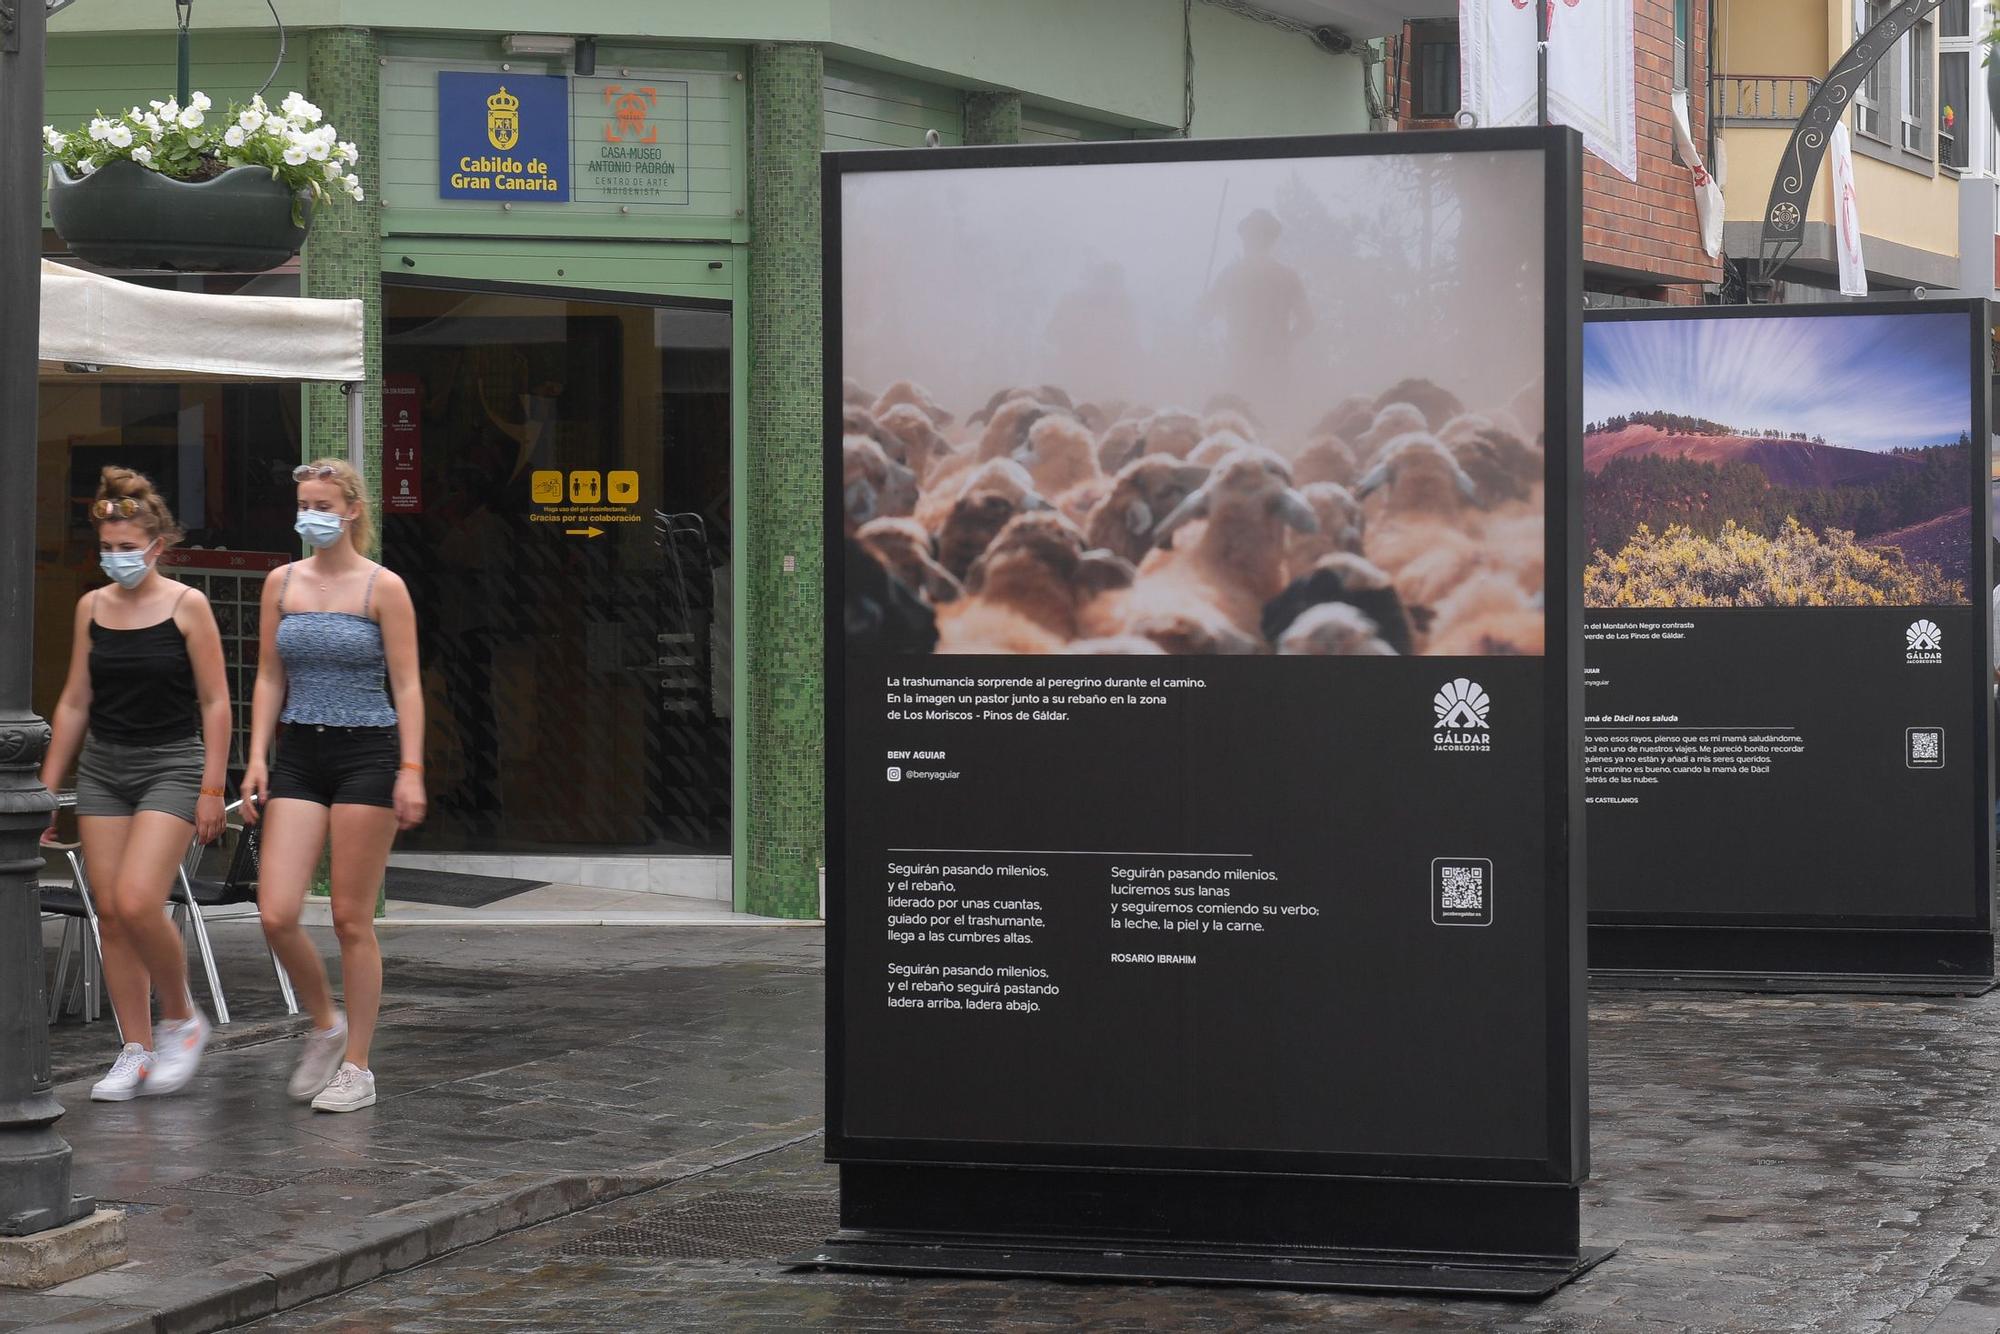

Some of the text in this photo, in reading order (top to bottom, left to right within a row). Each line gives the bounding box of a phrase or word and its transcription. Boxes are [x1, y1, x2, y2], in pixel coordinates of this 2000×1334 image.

[601, 146, 661, 161] CASA-MUSEO
[460, 156, 547, 174] Cabildo de
[588, 159, 675, 175] ANTONIO PADRÓN
[451, 173, 558, 191] Gran Canaria
[595, 176, 668, 187] CENTRO DE ARTE
[530, 513, 561, 522] Gracias
[562, 515, 576, 524] por
[589, 514, 641, 522] colaboración
[1639, 622, 1661, 630] Negro
[1906, 651, 1942, 660] GÁLDAR
[887, 676, 1207, 689] La trashumancia sorprende al peregrino durante el camino.
[887, 693, 901, 702] En
[904, 693, 913, 703] la
[915, 693, 955, 705] imagen
[958, 695, 972, 703] un
[975, 693, 1009, 705] pastor
[1011, 693, 1040, 705] junto
[1052, 695, 1065, 703] su
[1068, 694, 1107, 703] rebaño
[1110, 696, 1124, 704] en
[1127, 694, 1137, 704] la
[1140, 696, 1167, 704] zona
[887, 710, 1069, 720] de Los Moriscos Pinos de Gáldar.
[1433, 730, 1490, 743] GÁLDAR
[1654, 735, 1681, 743] pienso
[887, 750, 946, 759] BENY AGUIAR
[1674, 745, 1698, 753] viajes.
[1614, 756, 1624, 764] ya
[1736, 755, 1772, 763] queridos.
[906, 770, 960, 780] @benyaguiar
[1673, 765, 1702, 773] cuando
[1738, 765, 1749, 773] de
[1595, 796, 1639, 804] CASTELLANOS
[888, 862, 939, 877] Seguirán
[942, 863, 993, 877] pasando
[1111, 866, 1165, 881] Seguirán
[1168, 867, 1221, 881] pasando
[888, 882, 895, 892] y
[898, 880, 908, 890] el
[1111, 883, 1230, 896] luciremos sus lanas
[888, 896, 935, 908] liderado
[938, 899, 959, 910] por
[961, 899, 990, 909] unas
[1111, 901, 1319, 916] y seguiremos comiendo su verbo;
[888, 913, 927, 926] guiado
[930, 916, 951, 926] por
[954, 914, 965, 925] el
[1111, 917, 1121, 928] la
[1164, 918, 1174, 929] la
[1177, 919, 1199, 932] piel
[1202, 921, 1209, 932] y
[1213, 919, 1223, 930] la
[1226, 922, 1264, 931] carne.
[888, 929, 1033, 943] llega a las cumbres altas.
[1111, 953, 1196, 964] ROSARIO IBRAHIM
[888, 962, 939, 977] Seguirán
[943, 964, 994, 978] pasando
[888, 980, 1059, 996] y el rebaño seguirá pastando
[888, 996, 924, 1007] ladera
[966, 998, 1003, 1010] ladera
[1006, 999, 1040, 1013] abajo.
